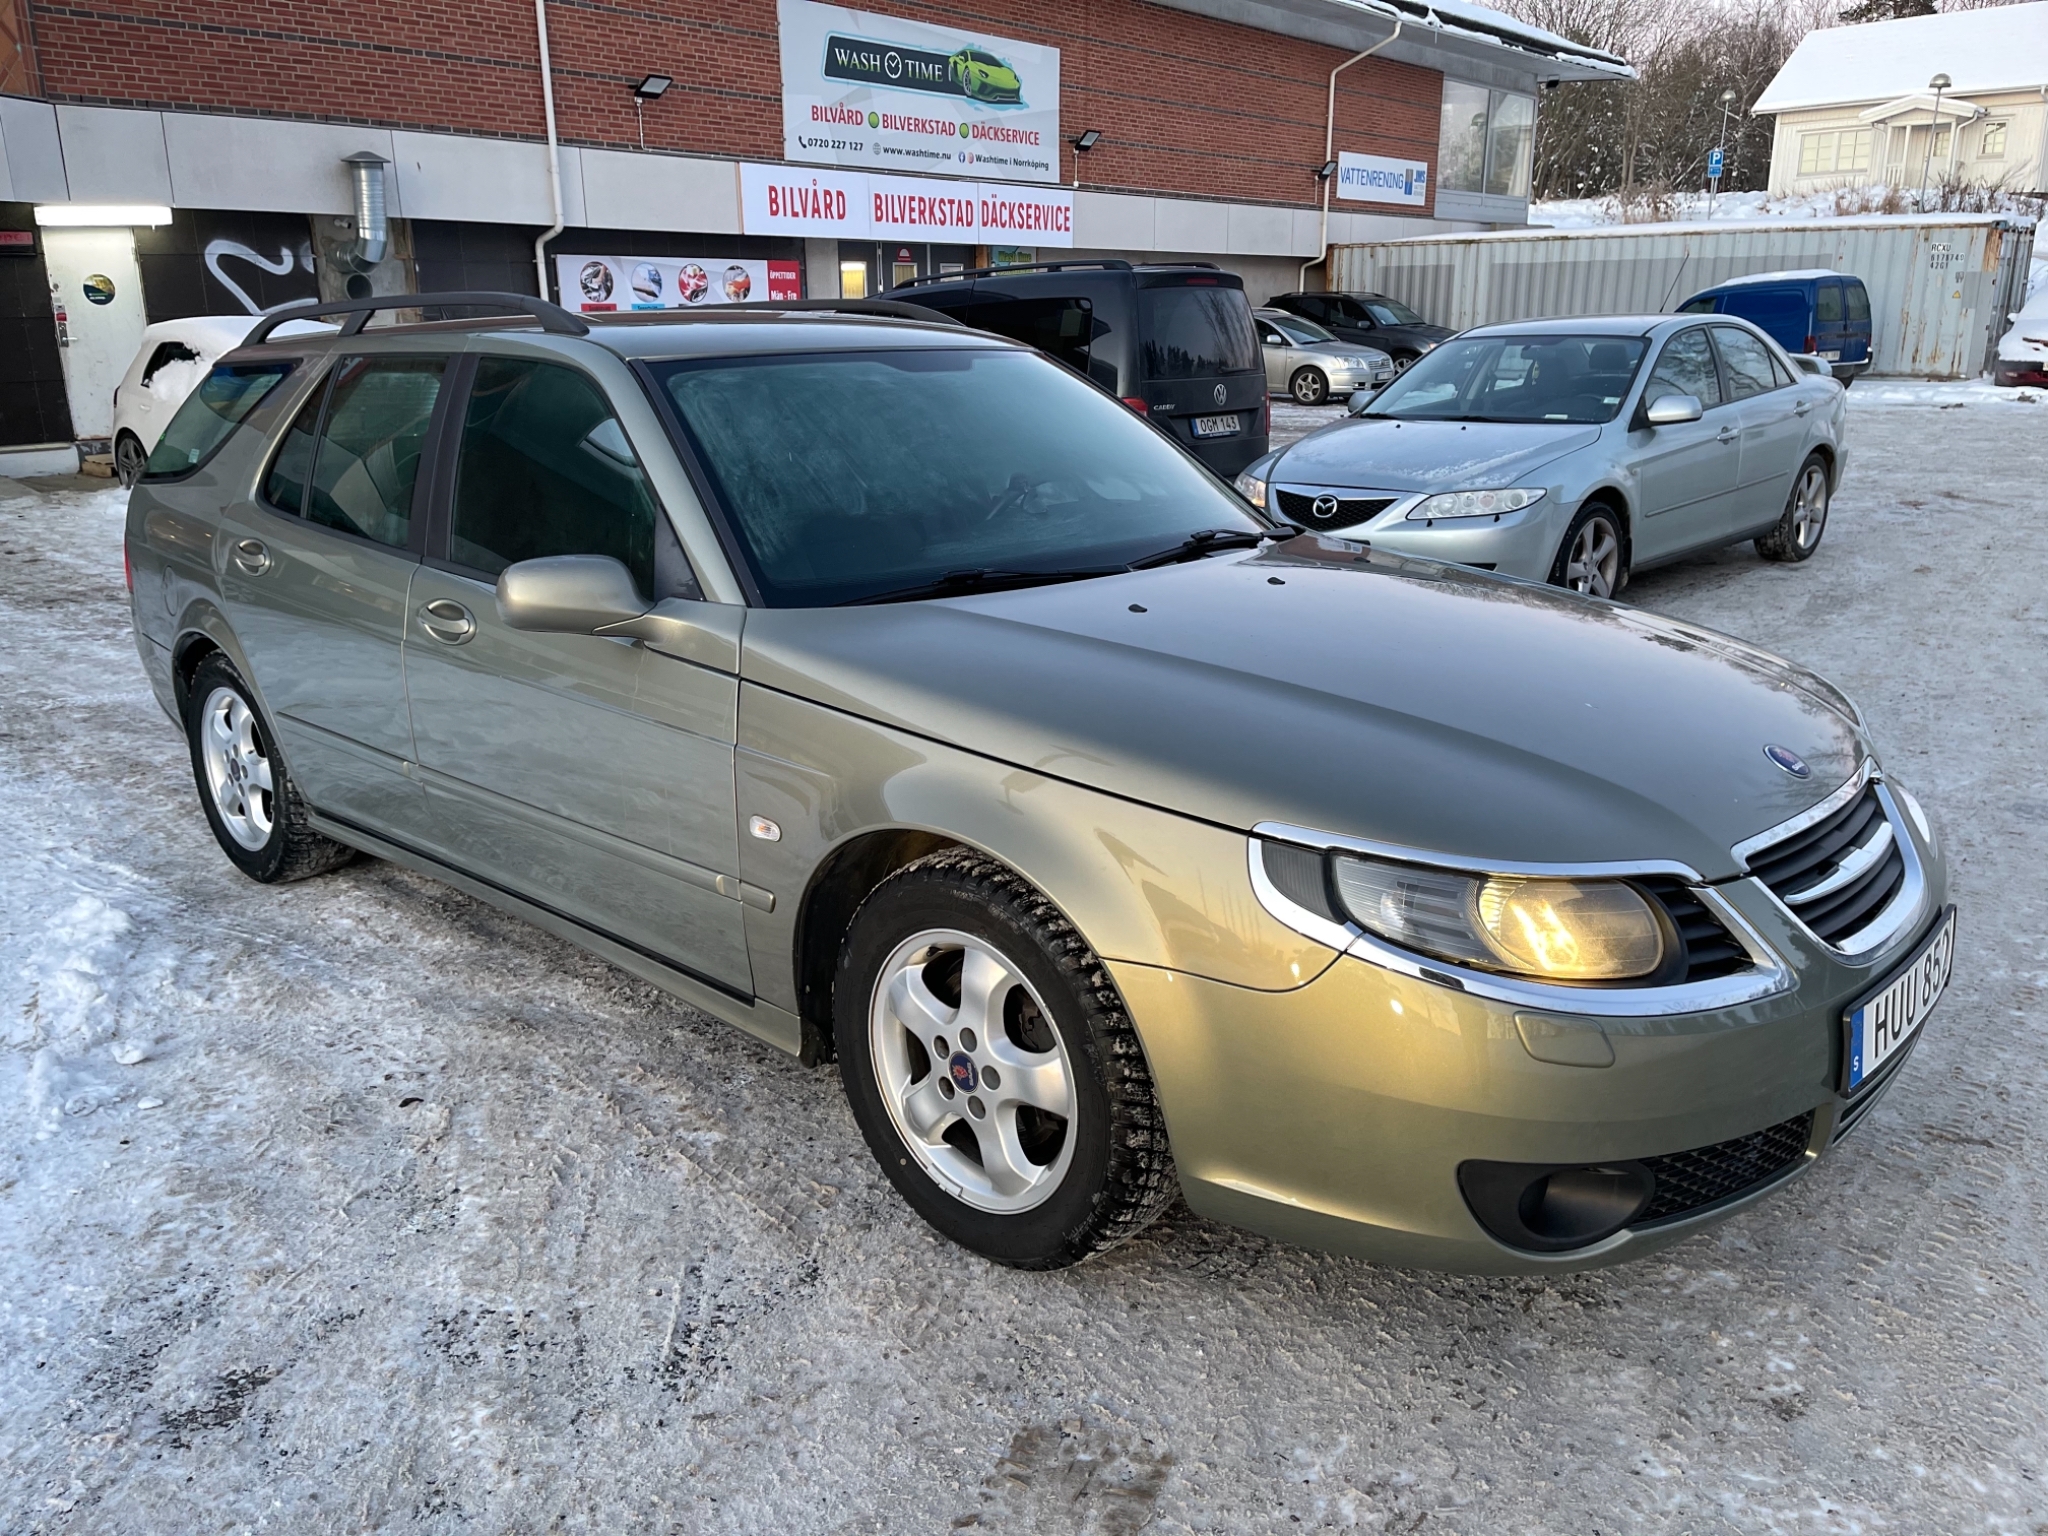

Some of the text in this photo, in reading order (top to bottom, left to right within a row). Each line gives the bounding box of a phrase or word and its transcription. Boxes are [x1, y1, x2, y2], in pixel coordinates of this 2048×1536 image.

[835, 47, 944, 82] WASH TIME
[811, 102, 1040, 146] BILVÅRD BILVERKSTAD DÄCKSERVICE
[807, 137, 863, 151] 0720 227 127
[883, 145, 951, 160] www.washtime.nu
[975, 154, 1008, 166] Washtime
[1013, 157, 1049, 171] Norrköping
[1712, 152, 1721, 165] P
[1340, 166, 1404, 189] VATTENRENING
[768, 179, 1071, 232] BILVÅRD BILVERKSTAD DÄCKSERVICE
[1931, 243, 1952, 252] RCXU
[770, 269, 797, 280] ÖPPETTIDER
[1153, 403, 1176, 411] CADDY
[1200, 415, 1237, 433] OGM 143
[1873, 927, 1949, 1060] HUU 852
[1853, 1055, 1860, 1072] S
